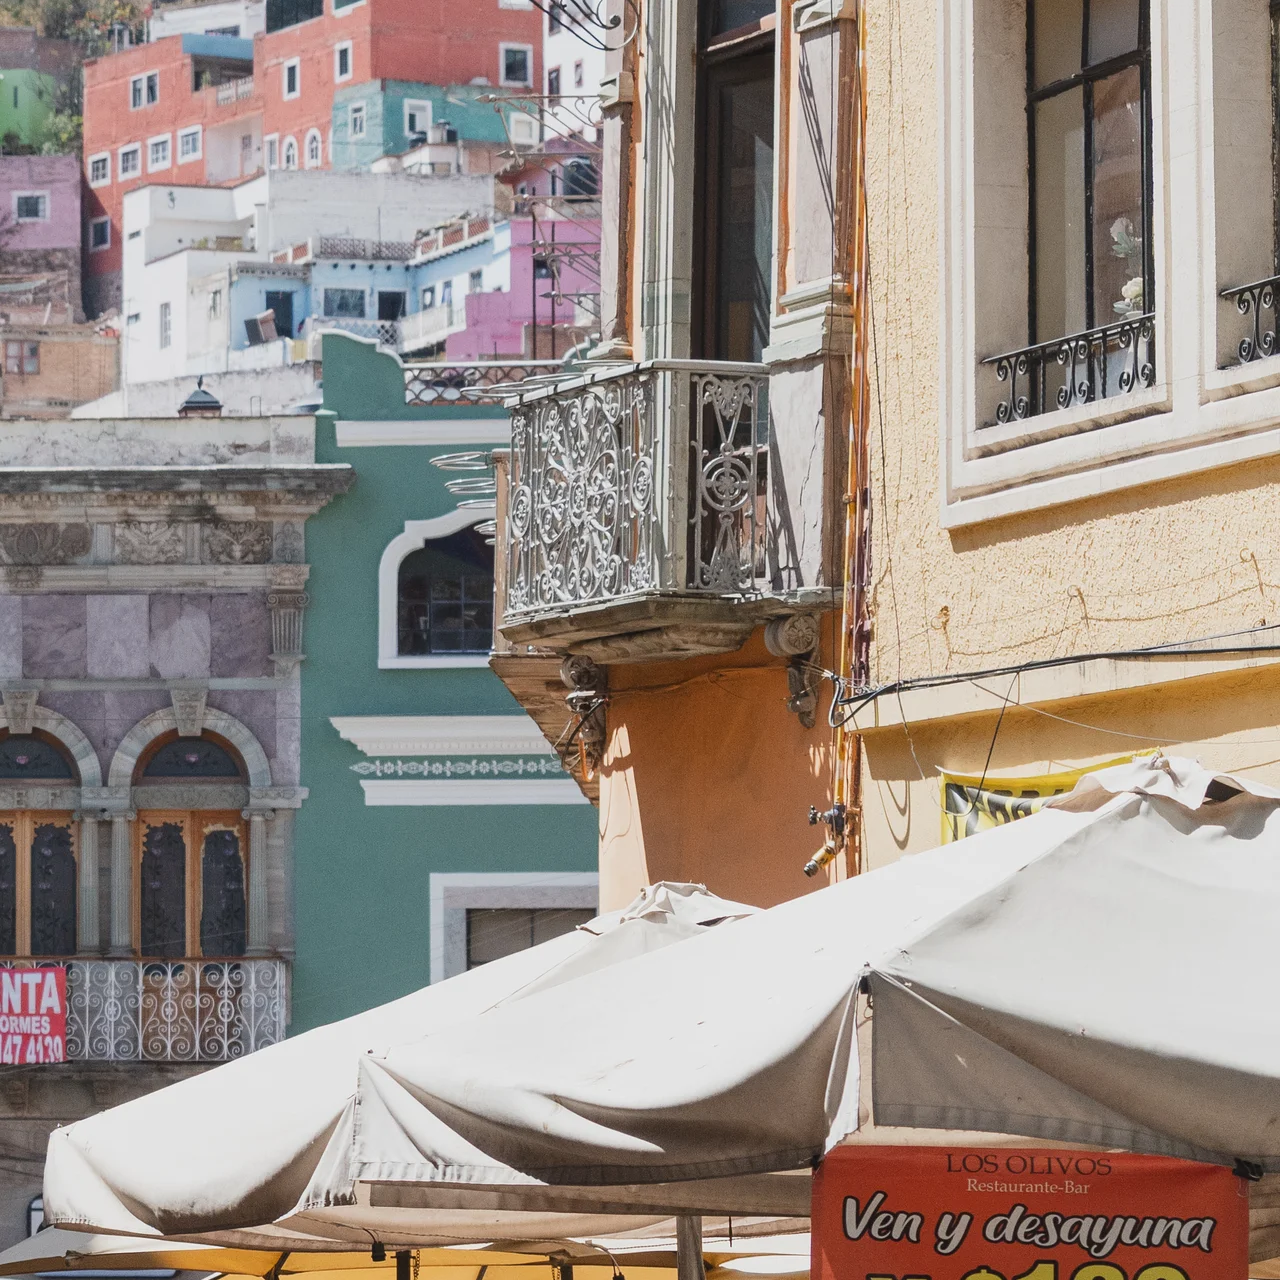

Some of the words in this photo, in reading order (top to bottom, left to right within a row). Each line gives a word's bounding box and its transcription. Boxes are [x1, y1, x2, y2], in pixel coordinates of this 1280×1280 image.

[26, 1035, 63, 1064] 4139
[945, 1152, 999, 1174] LOS
[1006, 1153, 1113, 1177] OLIVOS
[966, 1177, 1091, 1196] Restaurante-Bar
[844, 1191, 923, 1243] Ven
[934, 1211, 973, 1255] y
[983, 1204, 1216, 1258] desayuna
